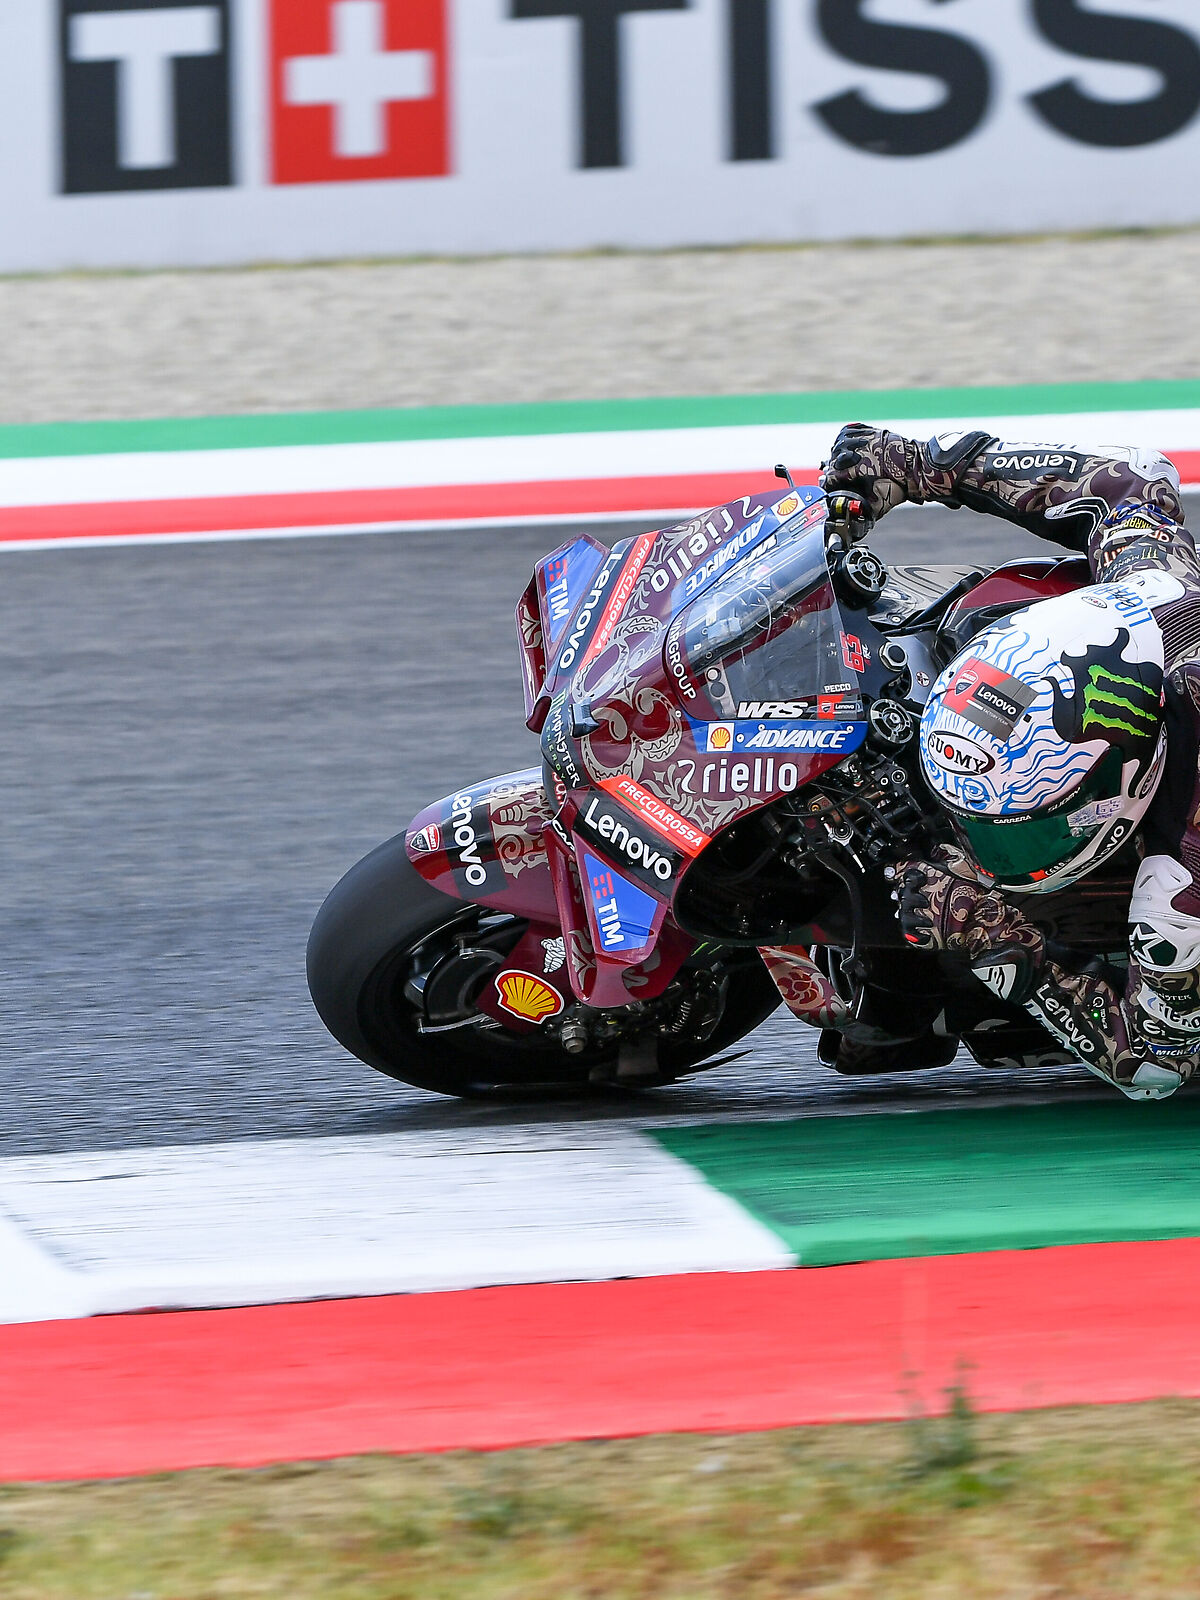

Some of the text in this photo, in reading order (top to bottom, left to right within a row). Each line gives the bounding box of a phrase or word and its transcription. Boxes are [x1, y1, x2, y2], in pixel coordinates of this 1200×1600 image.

[992, 452, 1078, 474] Lenovo
[650, 509, 734, 592] riello
[685, 515, 765, 596] ADVANCE
[549, 577, 569, 621] TIM
[559, 552, 624, 669] Lenovo
[594, 538, 650, 650] FRECCIAROSSA
[668, 617, 697, 699] VARGROUP
[824, 683, 851, 693] PECCO
[736, 701, 809, 718] WRS
[977, 686, 1017, 715] Lenovo
[551, 706, 580, 788] MONSTER
[745, 729, 849, 749] ADVANCE
[703, 758, 798, 793] riello
[452, 793, 488, 886] enovo
[583, 797, 674, 882] Lenovo
[618, 780, 703, 847] FRECCIAROSSA
[993, 815, 1032, 824] CARRERA
[597, 897, 624, 947] TIM
[1036, 983, 1095, 1053] Lenovo
